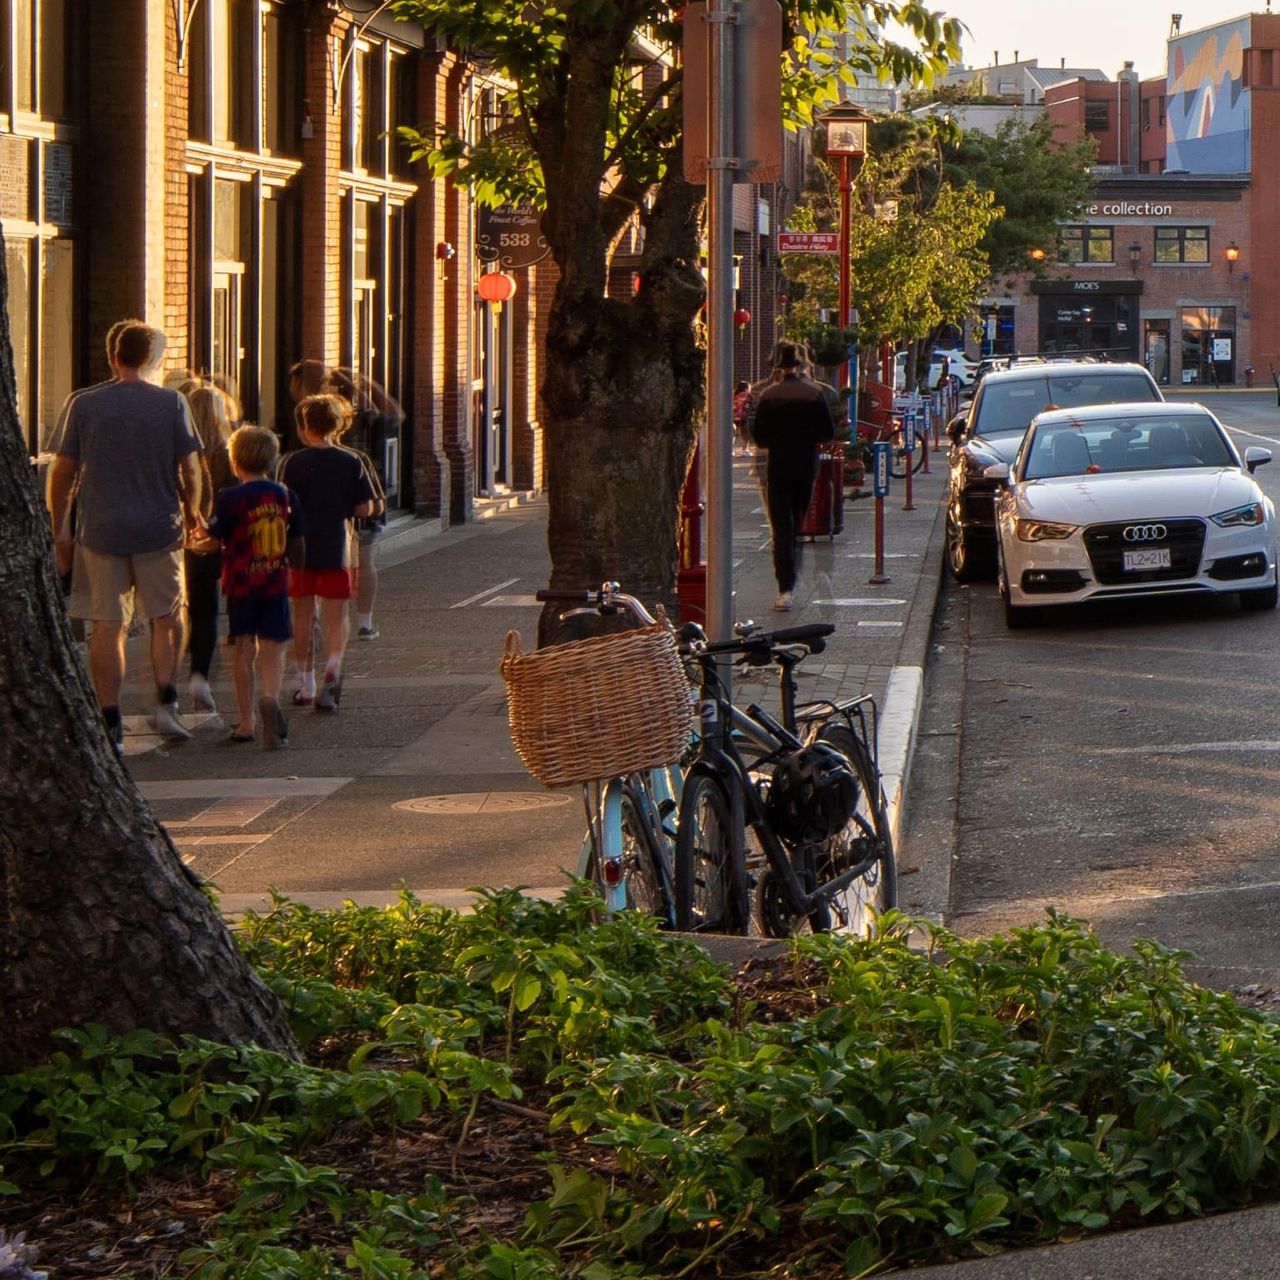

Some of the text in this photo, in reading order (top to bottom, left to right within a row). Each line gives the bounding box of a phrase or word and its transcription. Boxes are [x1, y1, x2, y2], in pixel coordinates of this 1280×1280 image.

[1102, 201, 1173, 217] collection
[500, 232, 530, 247] 533
[1073, 281, 1100, 291] MOE'S
